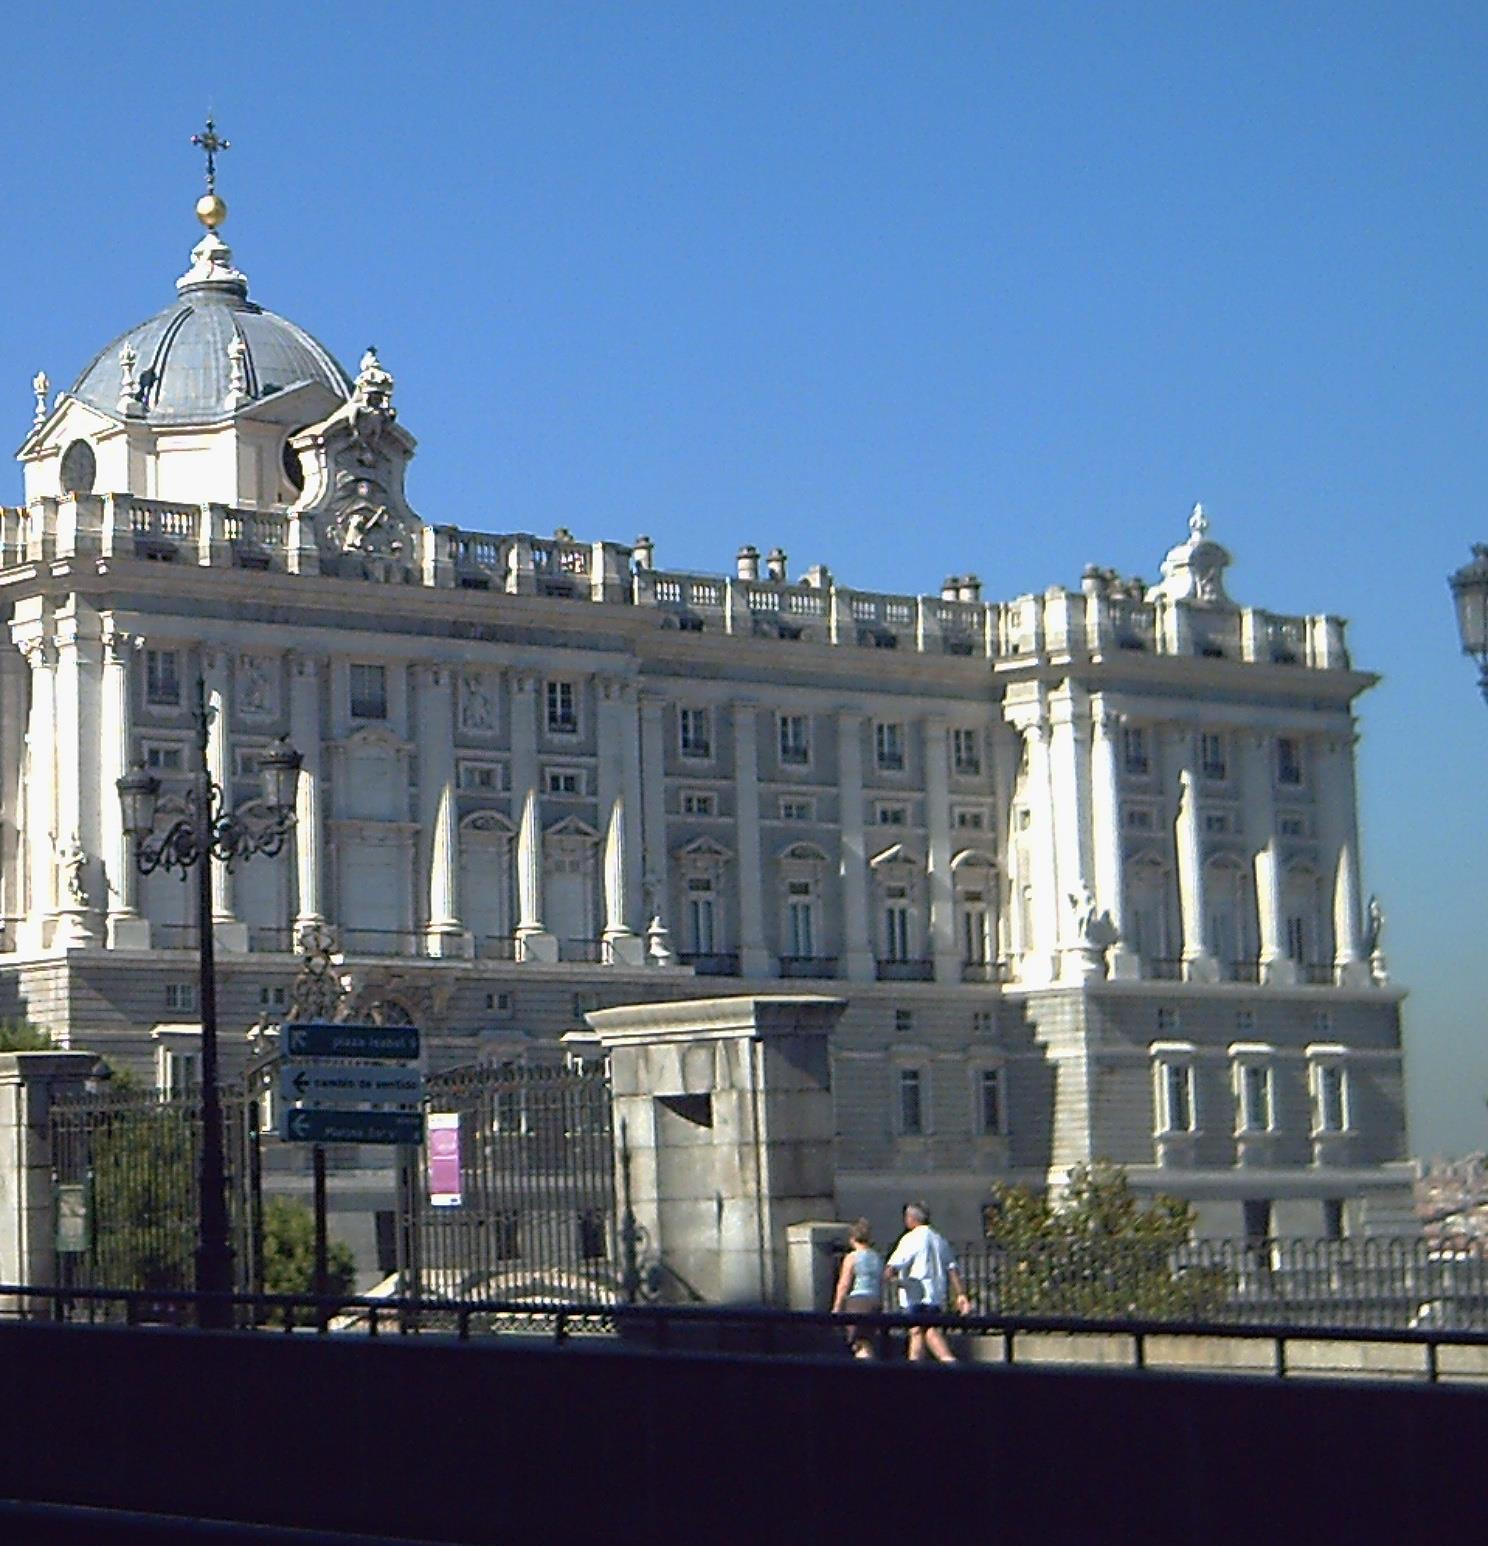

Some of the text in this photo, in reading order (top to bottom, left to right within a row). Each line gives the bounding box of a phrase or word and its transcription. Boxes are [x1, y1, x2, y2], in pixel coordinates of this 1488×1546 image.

[314, 1078, 418, 1090] cambio de sentido
